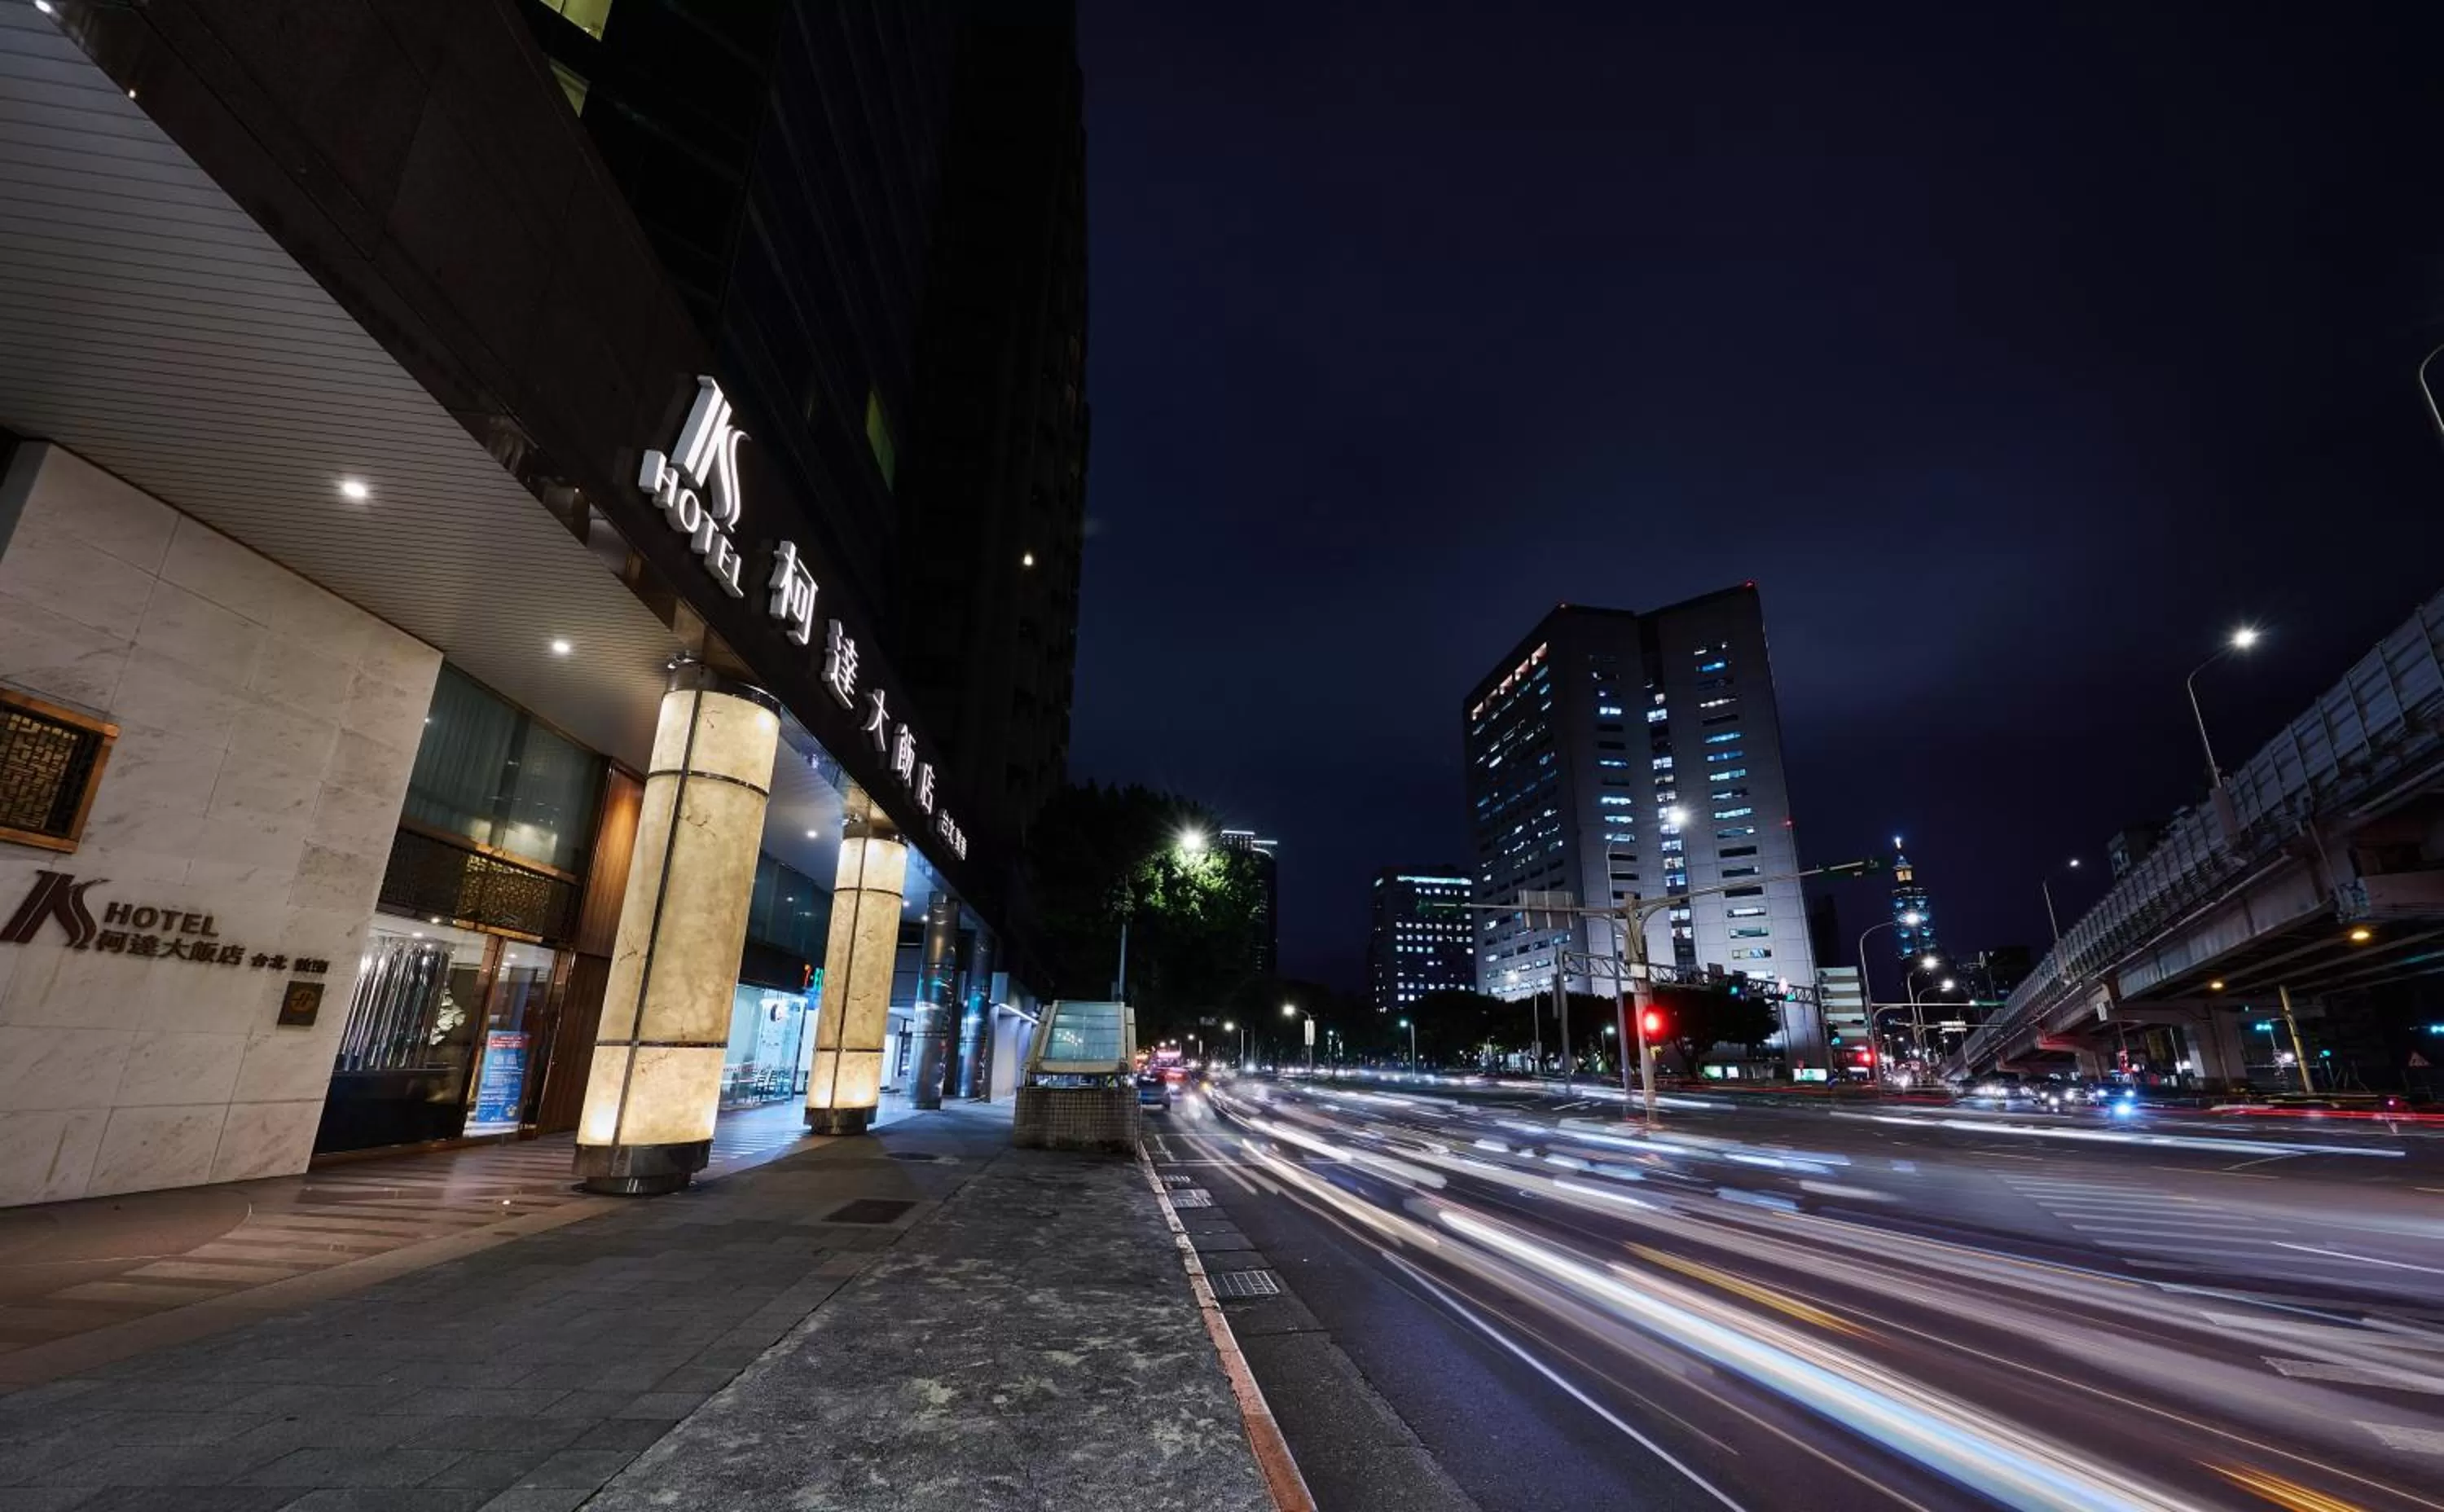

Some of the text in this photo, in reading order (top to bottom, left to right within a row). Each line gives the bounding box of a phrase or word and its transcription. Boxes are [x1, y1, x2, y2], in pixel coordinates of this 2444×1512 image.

[638, 449, 744, 599] HOTEL
[769, 540, 936, 814] 柯達大飯店
[96, 929, 246, 966] 柯達大飯店
[104, 901, 220, 938] HOTEL
